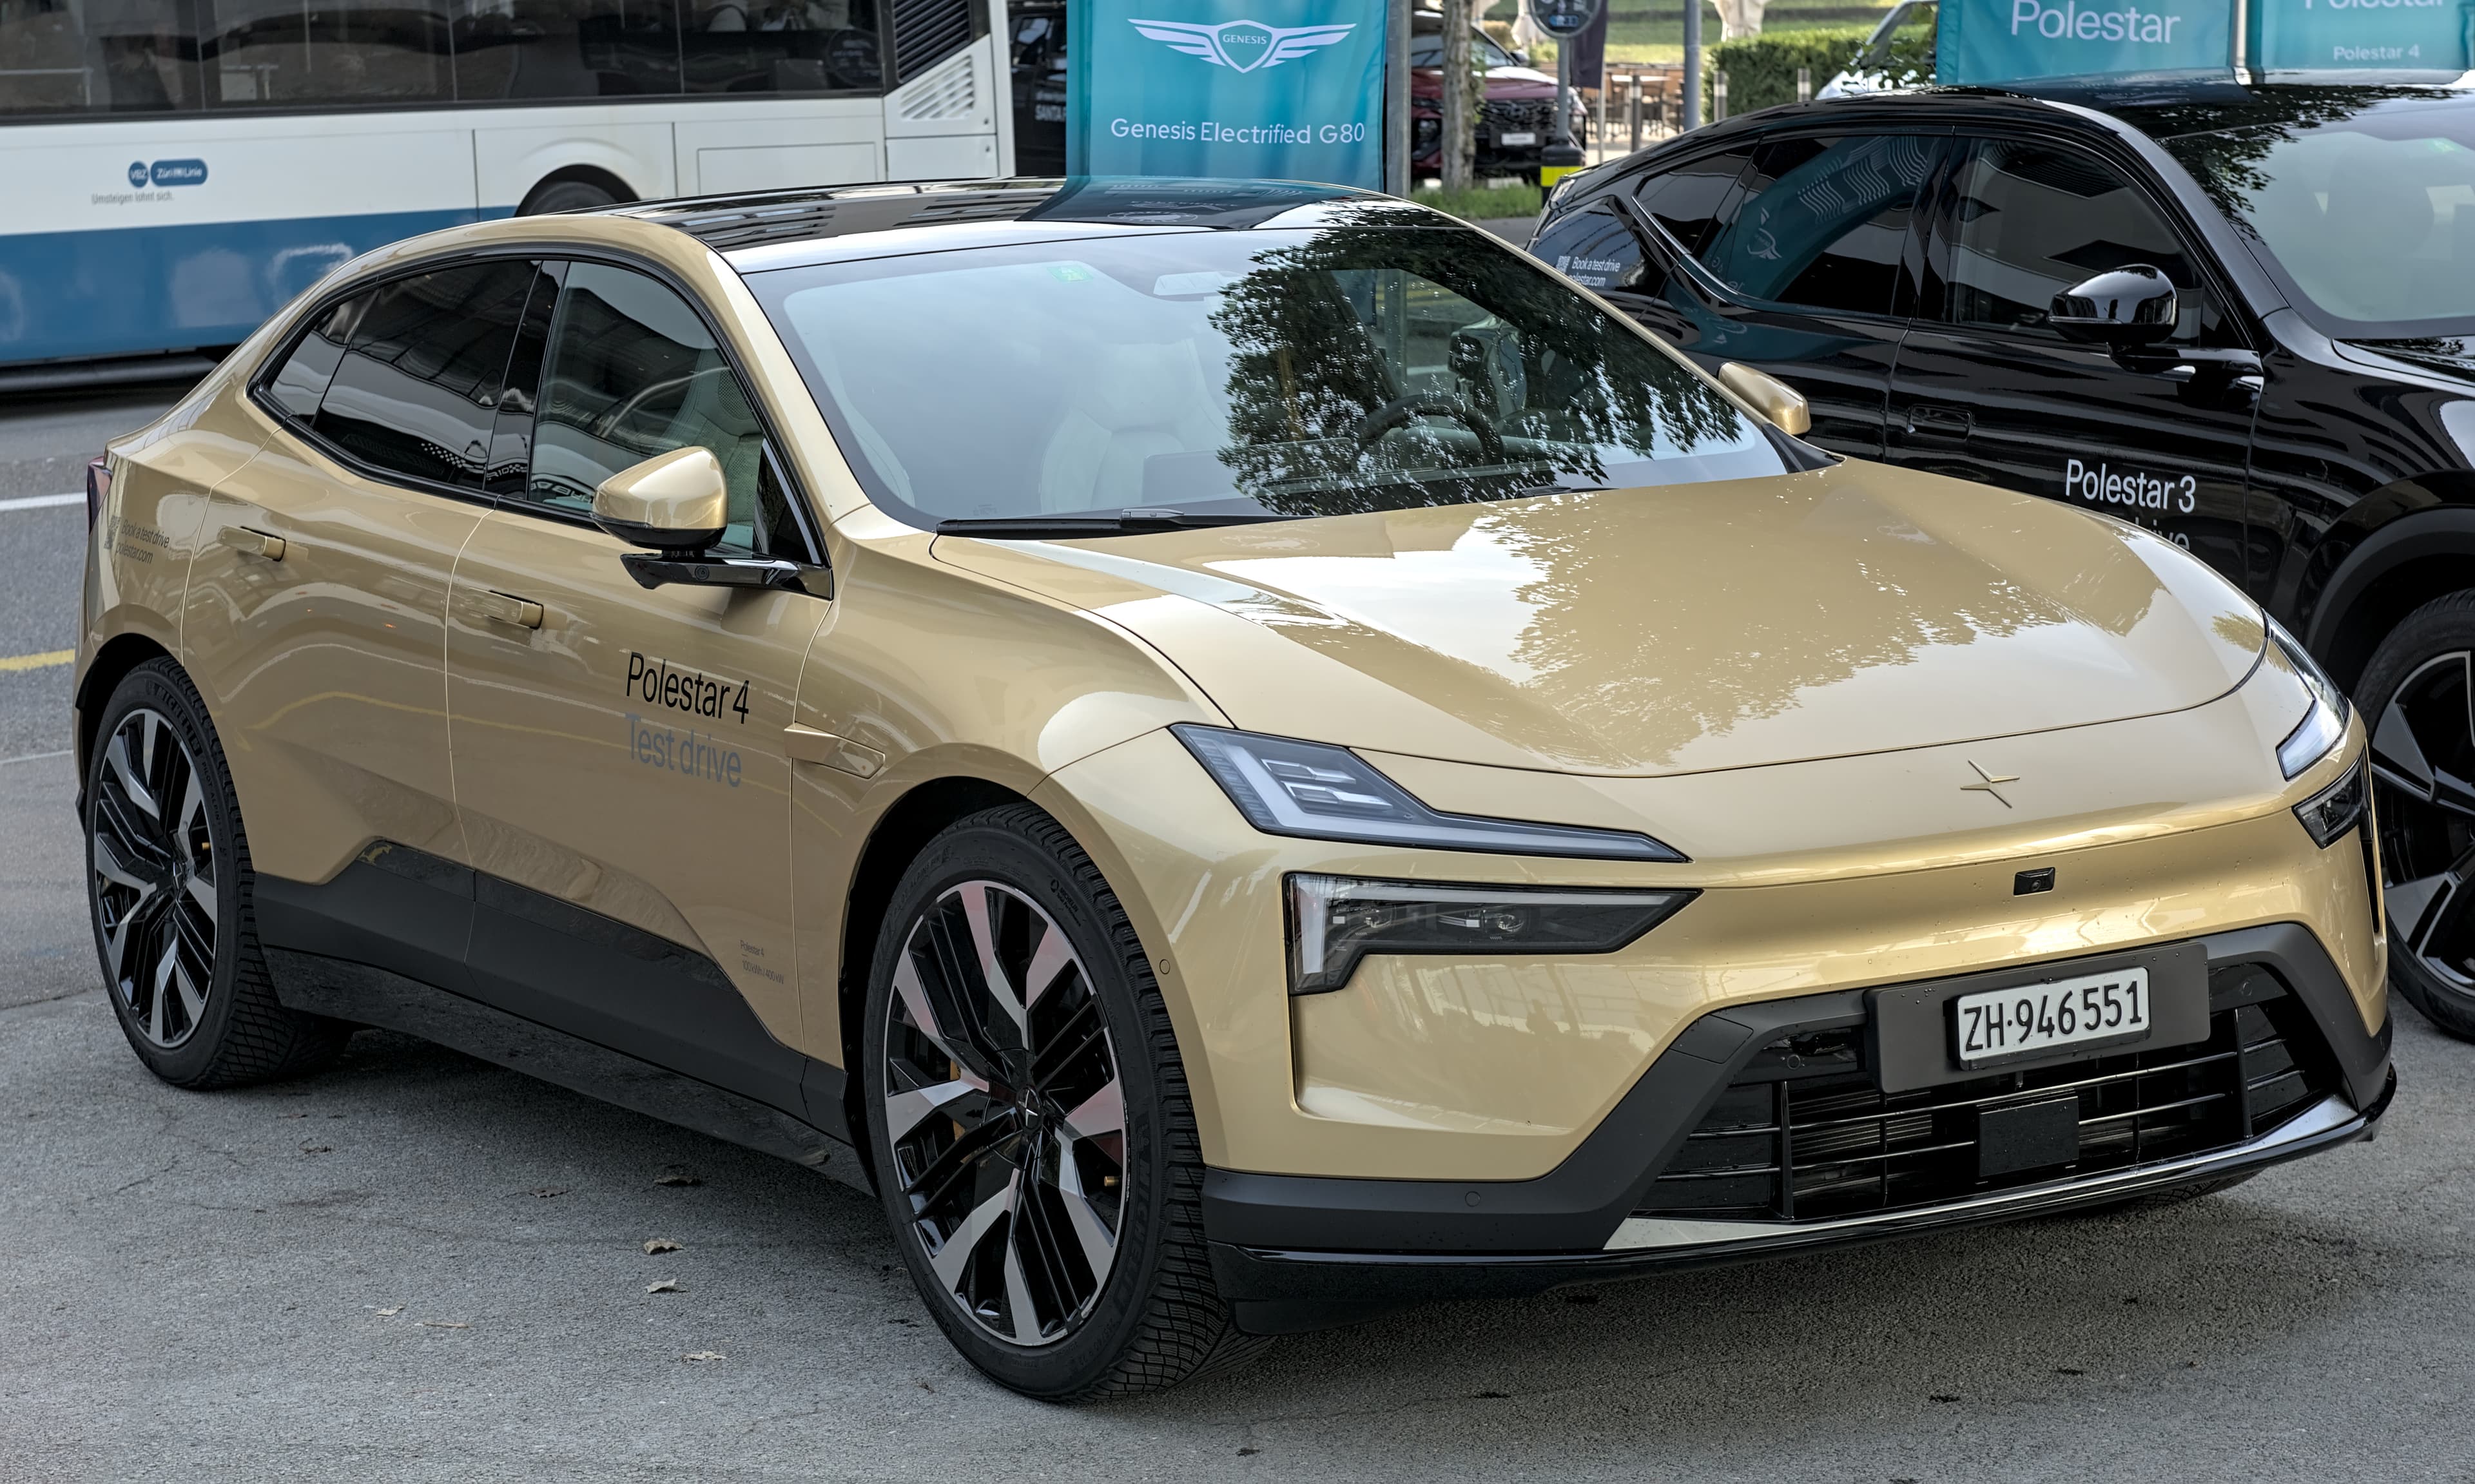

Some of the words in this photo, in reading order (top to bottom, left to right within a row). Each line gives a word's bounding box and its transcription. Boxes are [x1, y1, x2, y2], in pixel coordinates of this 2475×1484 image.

[2011, 0, 2182, 43] Polestar
[1222, 34, 1267, 44] GENESIS
[2333, 45, 2403, 61] Polestar
[2407, 44, 2421, 59] 4
[1111, 118, 1196, 141] Genesis
[1200, 121, 1311, 144] Electrified
[1319, 122, 1365, 144] G80
[130, 168, 148, 181] VBZ
[92, 193, 133, 205] Umsteigen
[135, 192, 155, 203] lohnt
[1571, 256, 1588, 269] Book
[1592, 259, 1604, 271] test
[1604, 258, 1620, 272] drive
[2064, 458, 2175, 510] Polestar
[2178, 475, 2197, 514] 3
[121, 519, 137, 537] Book
[140, 526, 153, 544] test
[153, 530, 170, 548] drive
[115, 541, 154, 564] polestar.com
[626, 651, 731, 719] Polestar
[732, 680, 750, 724] 4
[156, 686, 202, 754] MICHELIN
[625, 712, 675, 771] Test
[679, 729, 742, 787] drive
